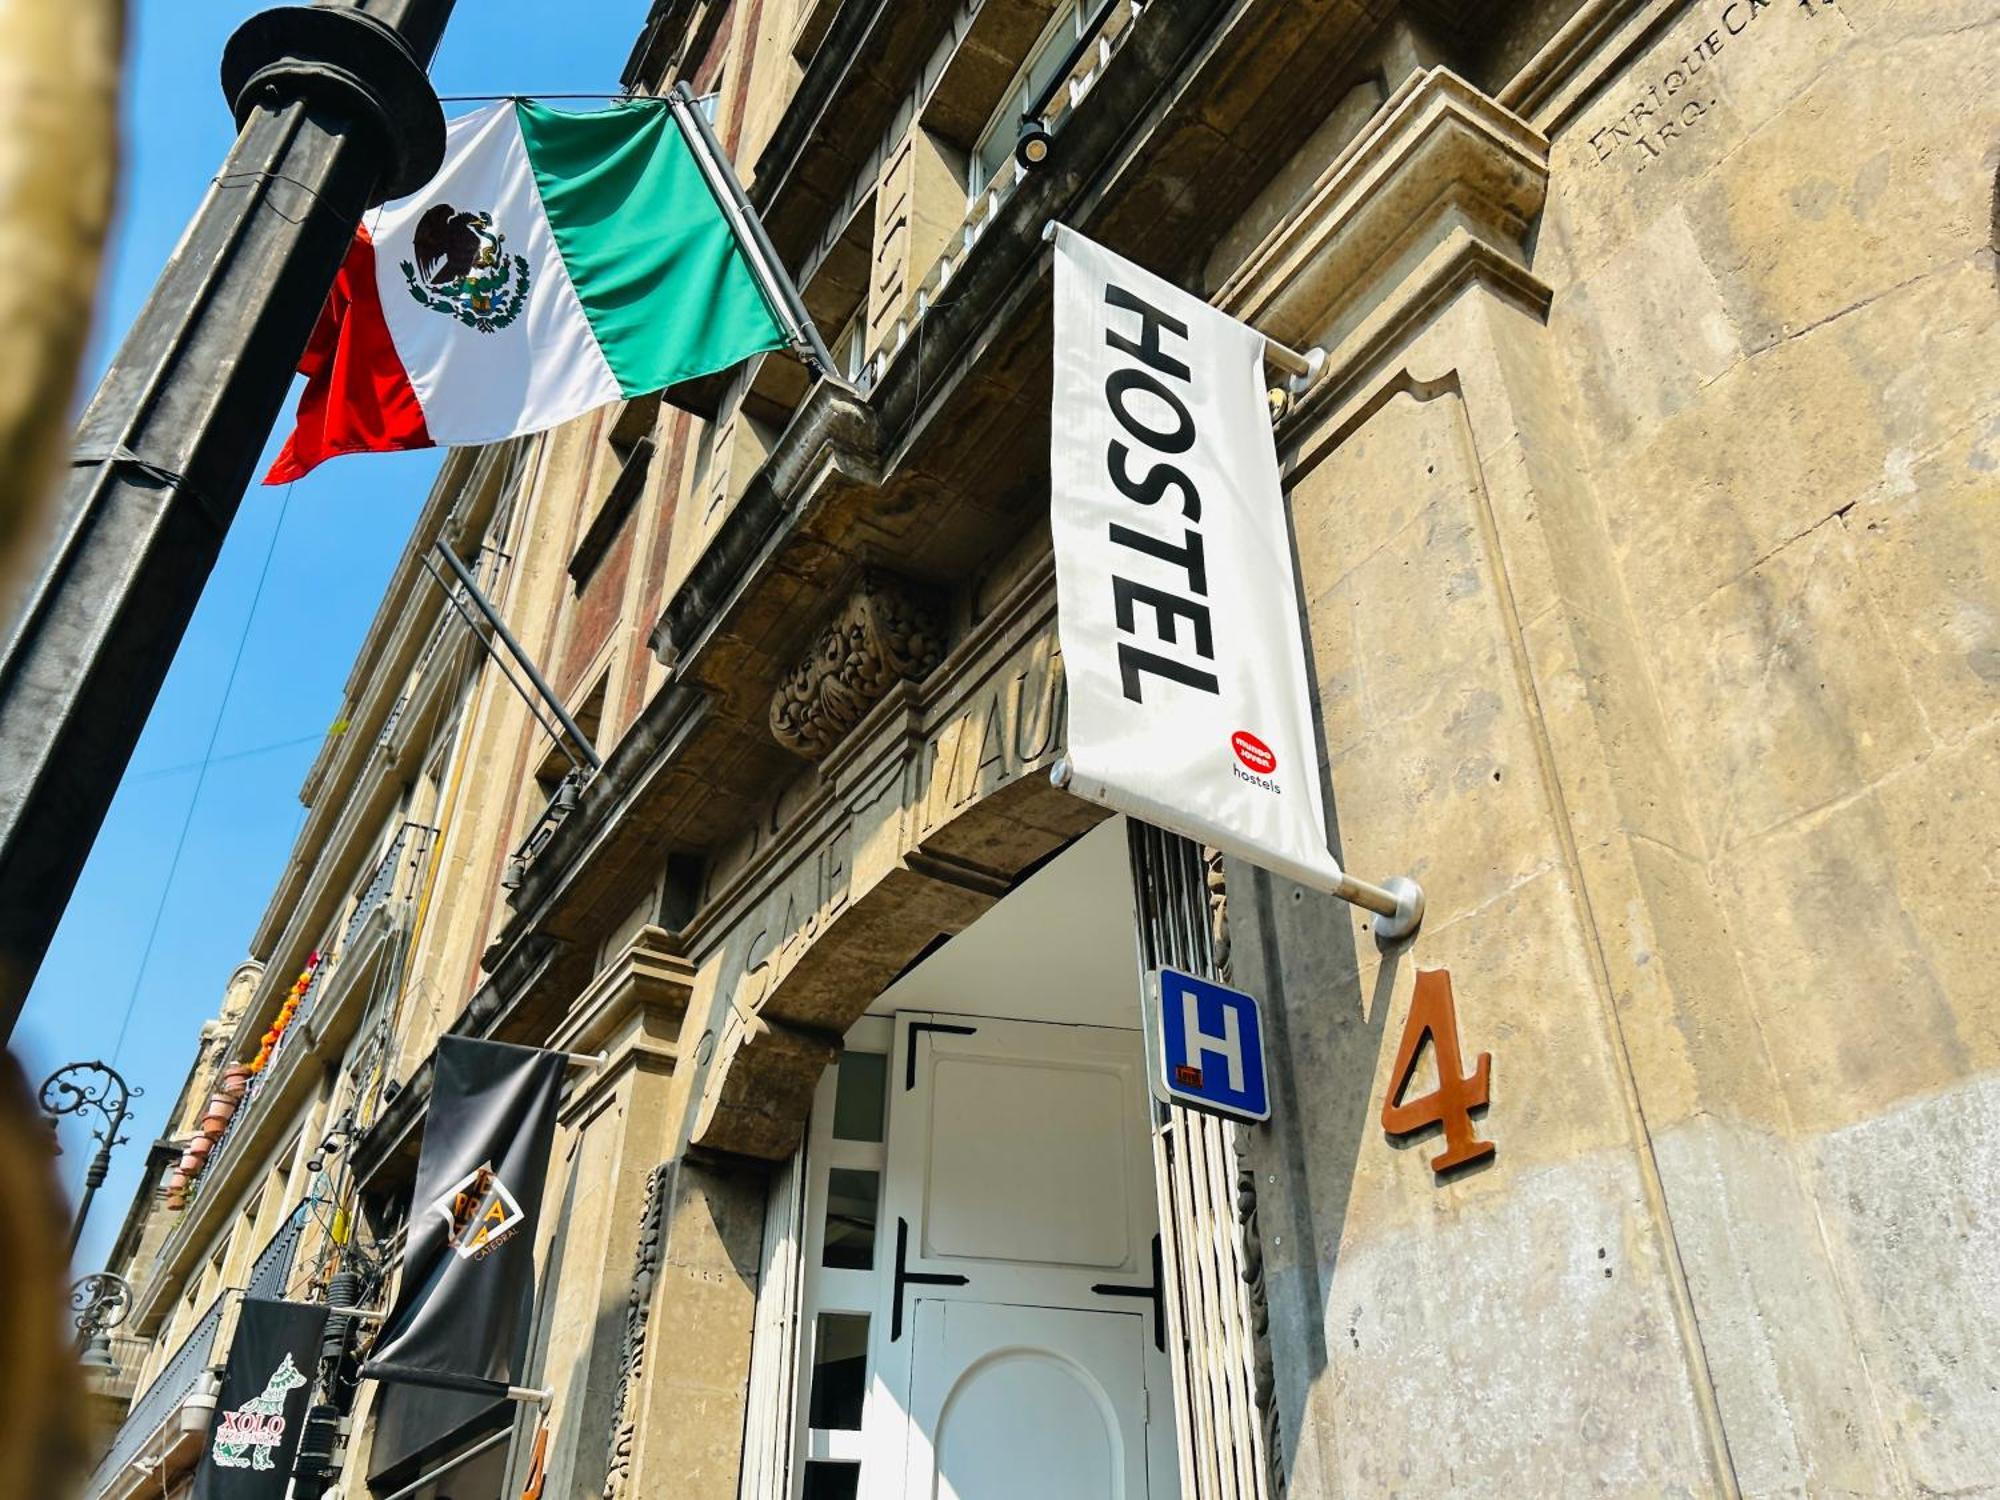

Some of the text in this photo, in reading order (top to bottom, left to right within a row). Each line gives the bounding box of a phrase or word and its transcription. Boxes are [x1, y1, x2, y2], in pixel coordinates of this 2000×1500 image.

[1104, 282, 1220, 705] HOSTEL
[1233, 763, 1281, 794] hostels
[1182, 990, 1245, 1093] H
[1382, 968, 1495, 1173] 4
[222, 1410, 286, 1436] XOLO
